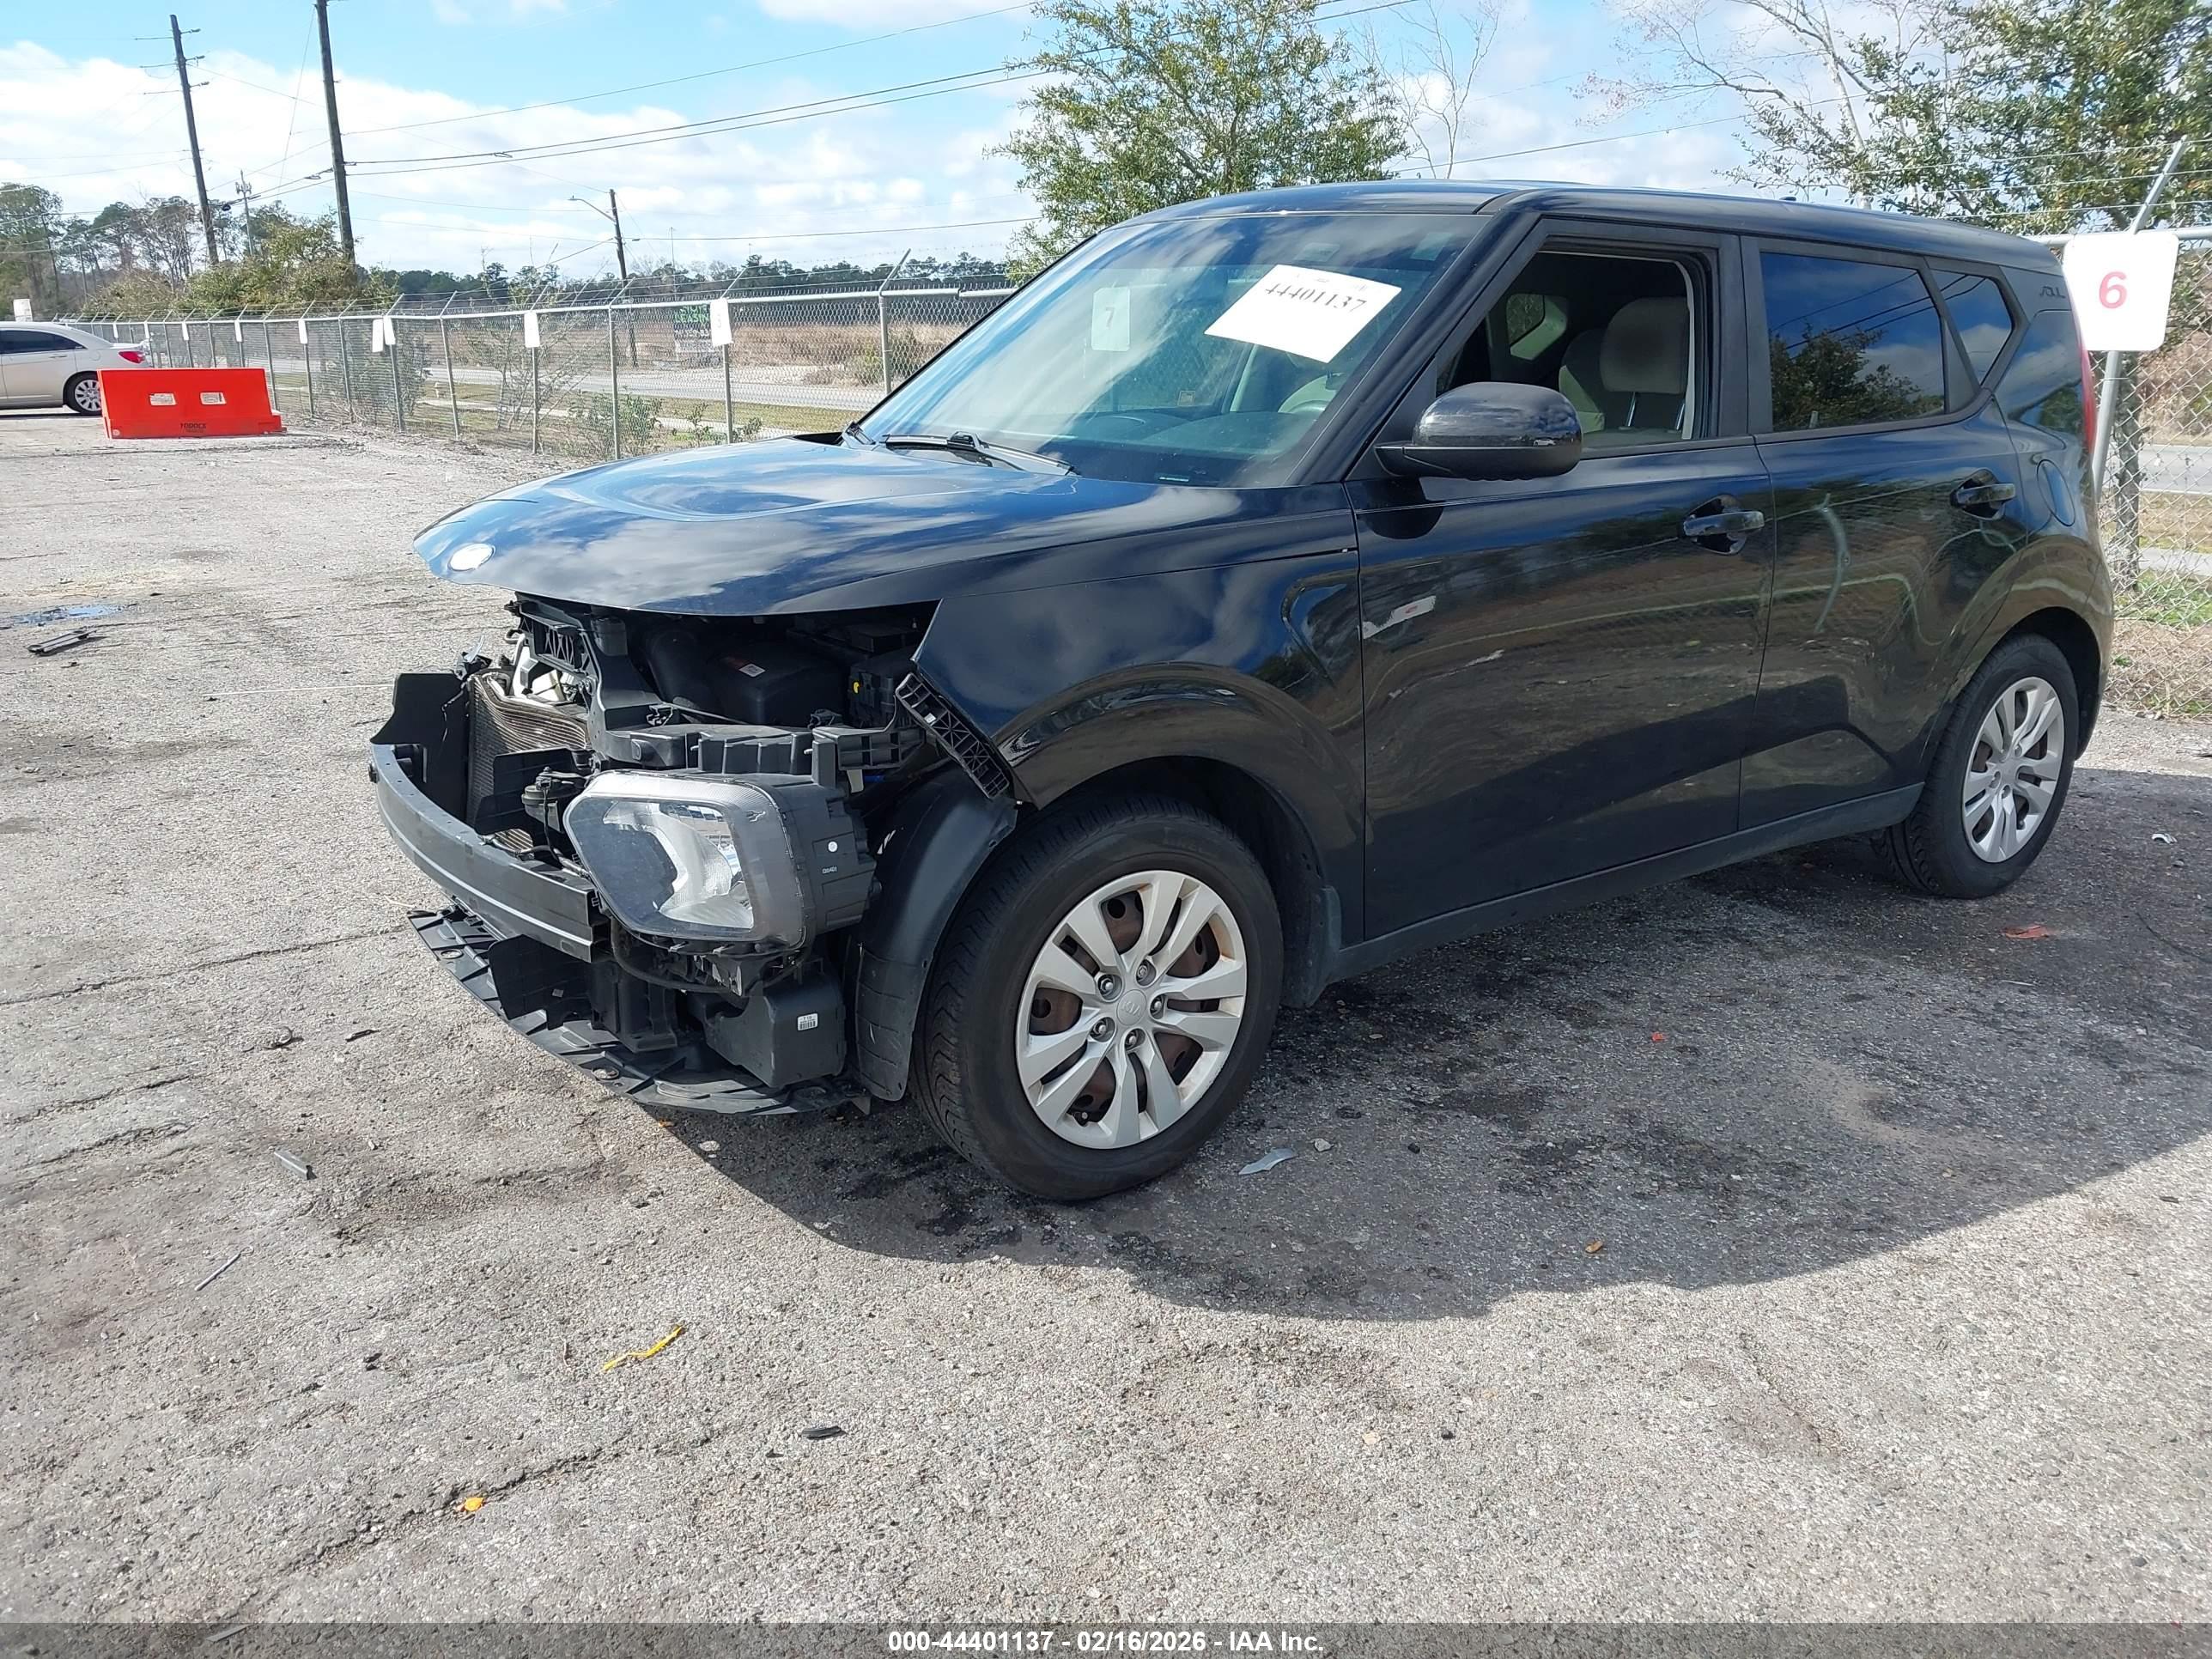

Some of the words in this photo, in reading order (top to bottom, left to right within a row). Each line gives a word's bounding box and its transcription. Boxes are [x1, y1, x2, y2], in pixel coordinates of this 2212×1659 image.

[1265, 282, 1368, 313] 44401137
[2099, 270, 2128, 309] 6
[1104, 306, 1116, 330] 7
